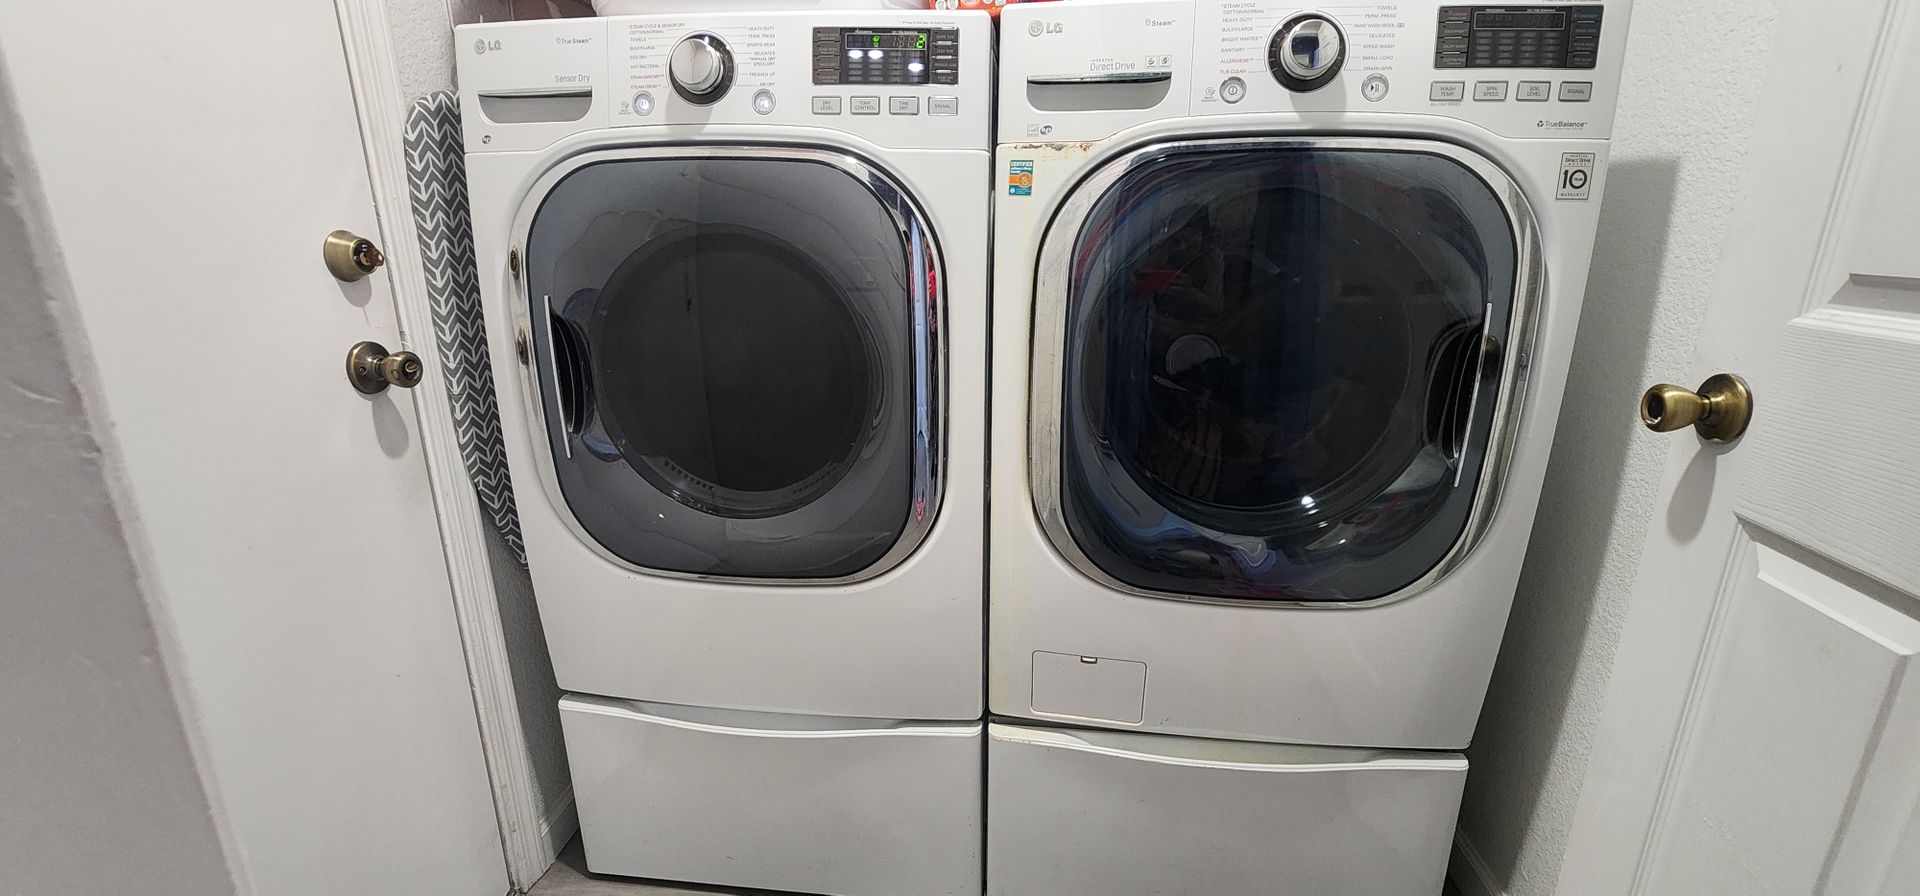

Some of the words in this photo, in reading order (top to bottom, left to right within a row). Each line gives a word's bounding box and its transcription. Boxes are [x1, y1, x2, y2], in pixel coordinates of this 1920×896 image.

[1046, 22, 1063, 34] LG
[488, 40, 502, 51] LG
[578, 74, 590, 82] Dry
[1562, 169, 1587, 189] 10
